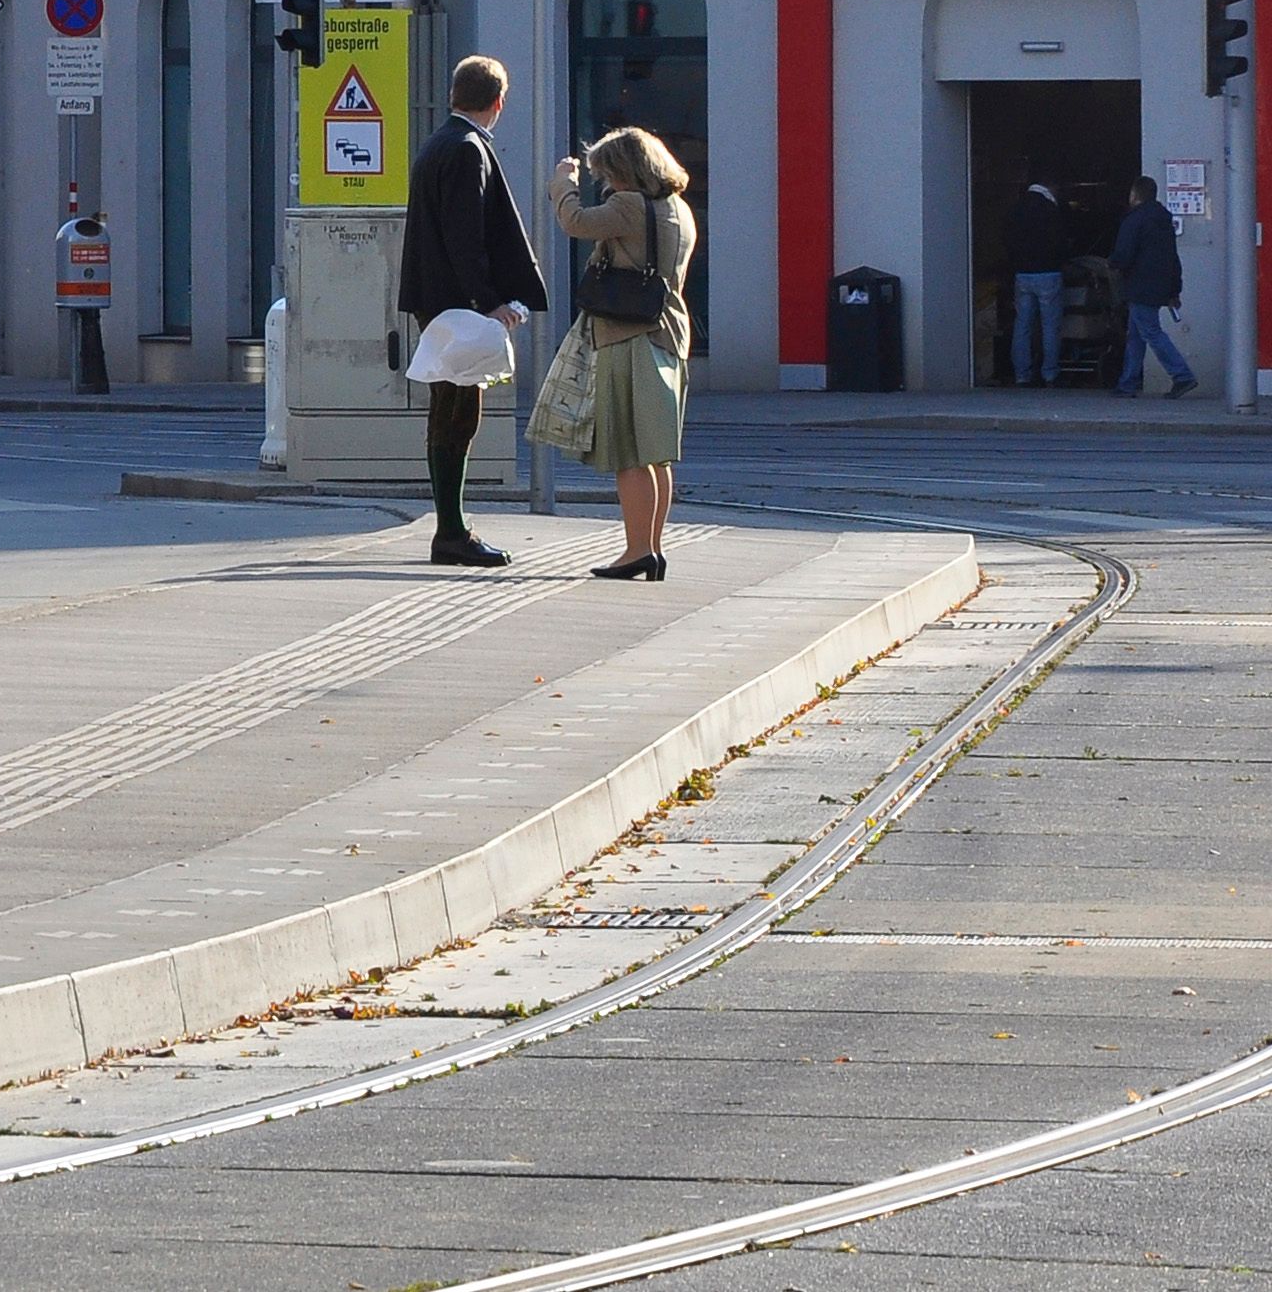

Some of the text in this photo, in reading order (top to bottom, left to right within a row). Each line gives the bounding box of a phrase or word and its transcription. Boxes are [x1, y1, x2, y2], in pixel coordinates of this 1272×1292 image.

[326, 35, 380, 53] gesperrt
[59, 99, 91, 112] Anfang
[343, 177, 365, 188] STAU
